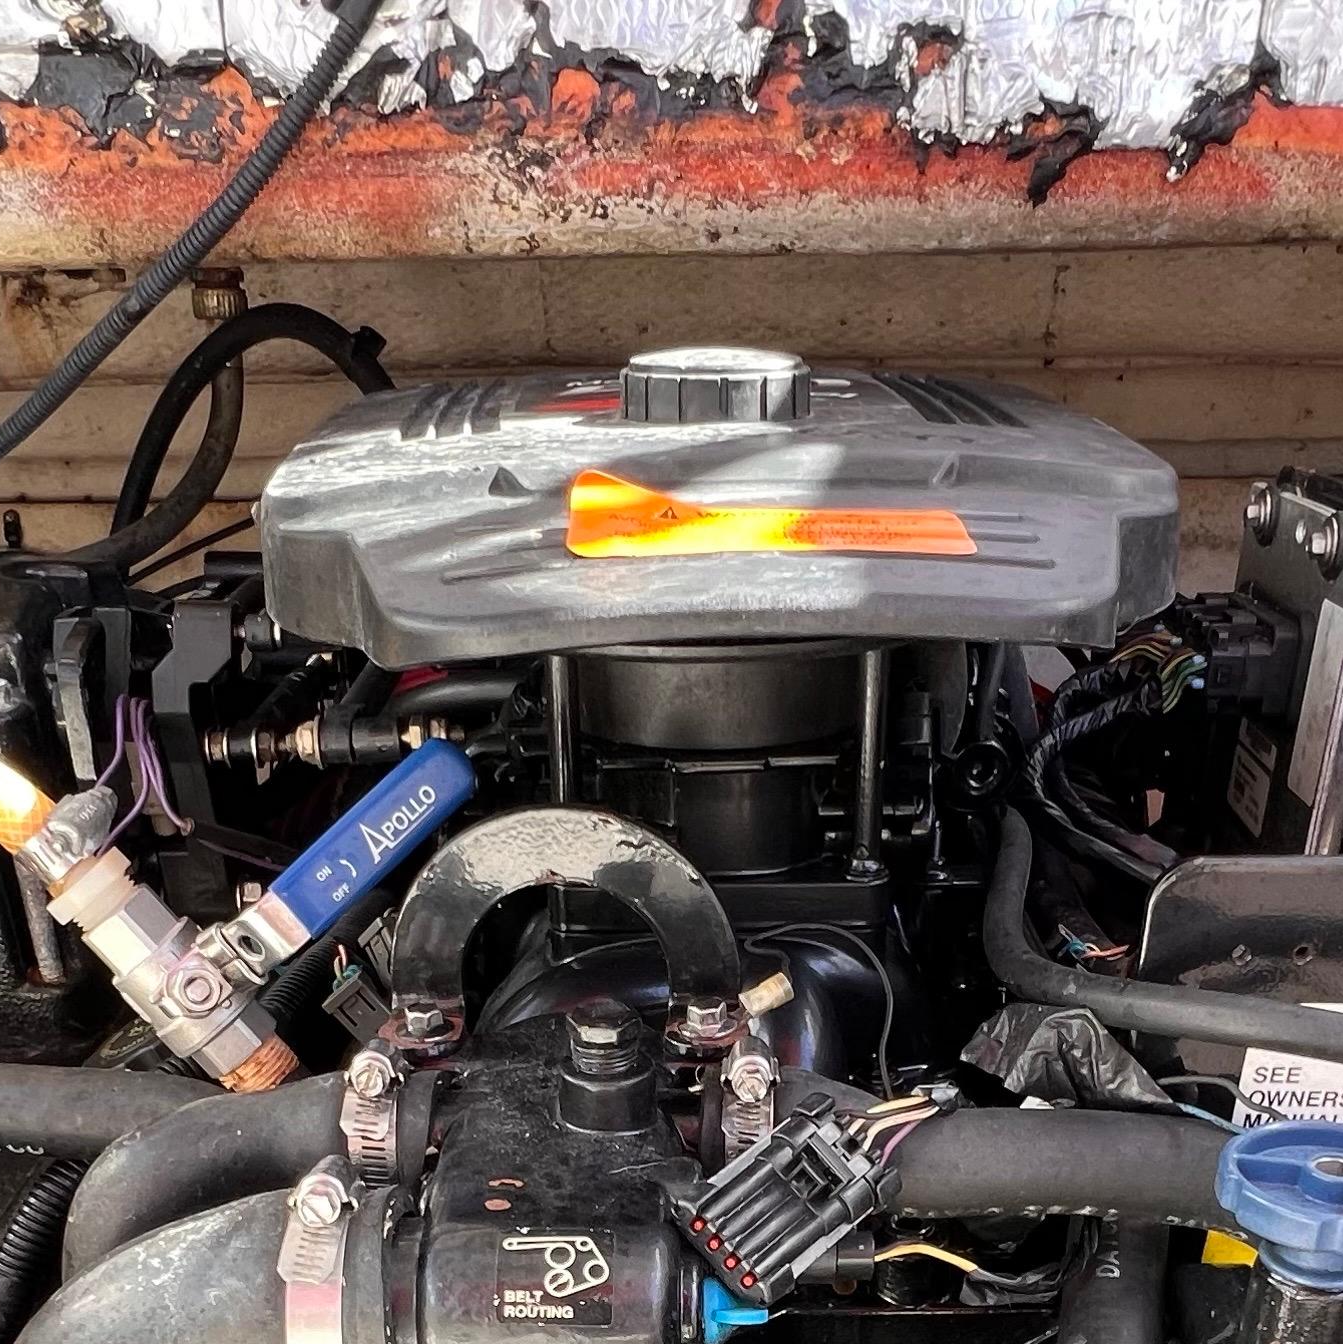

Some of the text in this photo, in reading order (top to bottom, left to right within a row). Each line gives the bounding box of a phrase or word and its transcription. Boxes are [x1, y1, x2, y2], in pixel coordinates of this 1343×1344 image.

[358, 784, 437, 864] APOLLO
[316, 865, 333, 882] ON
[332, 883, 350, 902] OFF
[1253, 1066, 1303, 1084] SEE
[503, 1289, 545, 1304] BELT
[503, 1305, 575, 1319] ROUTING
